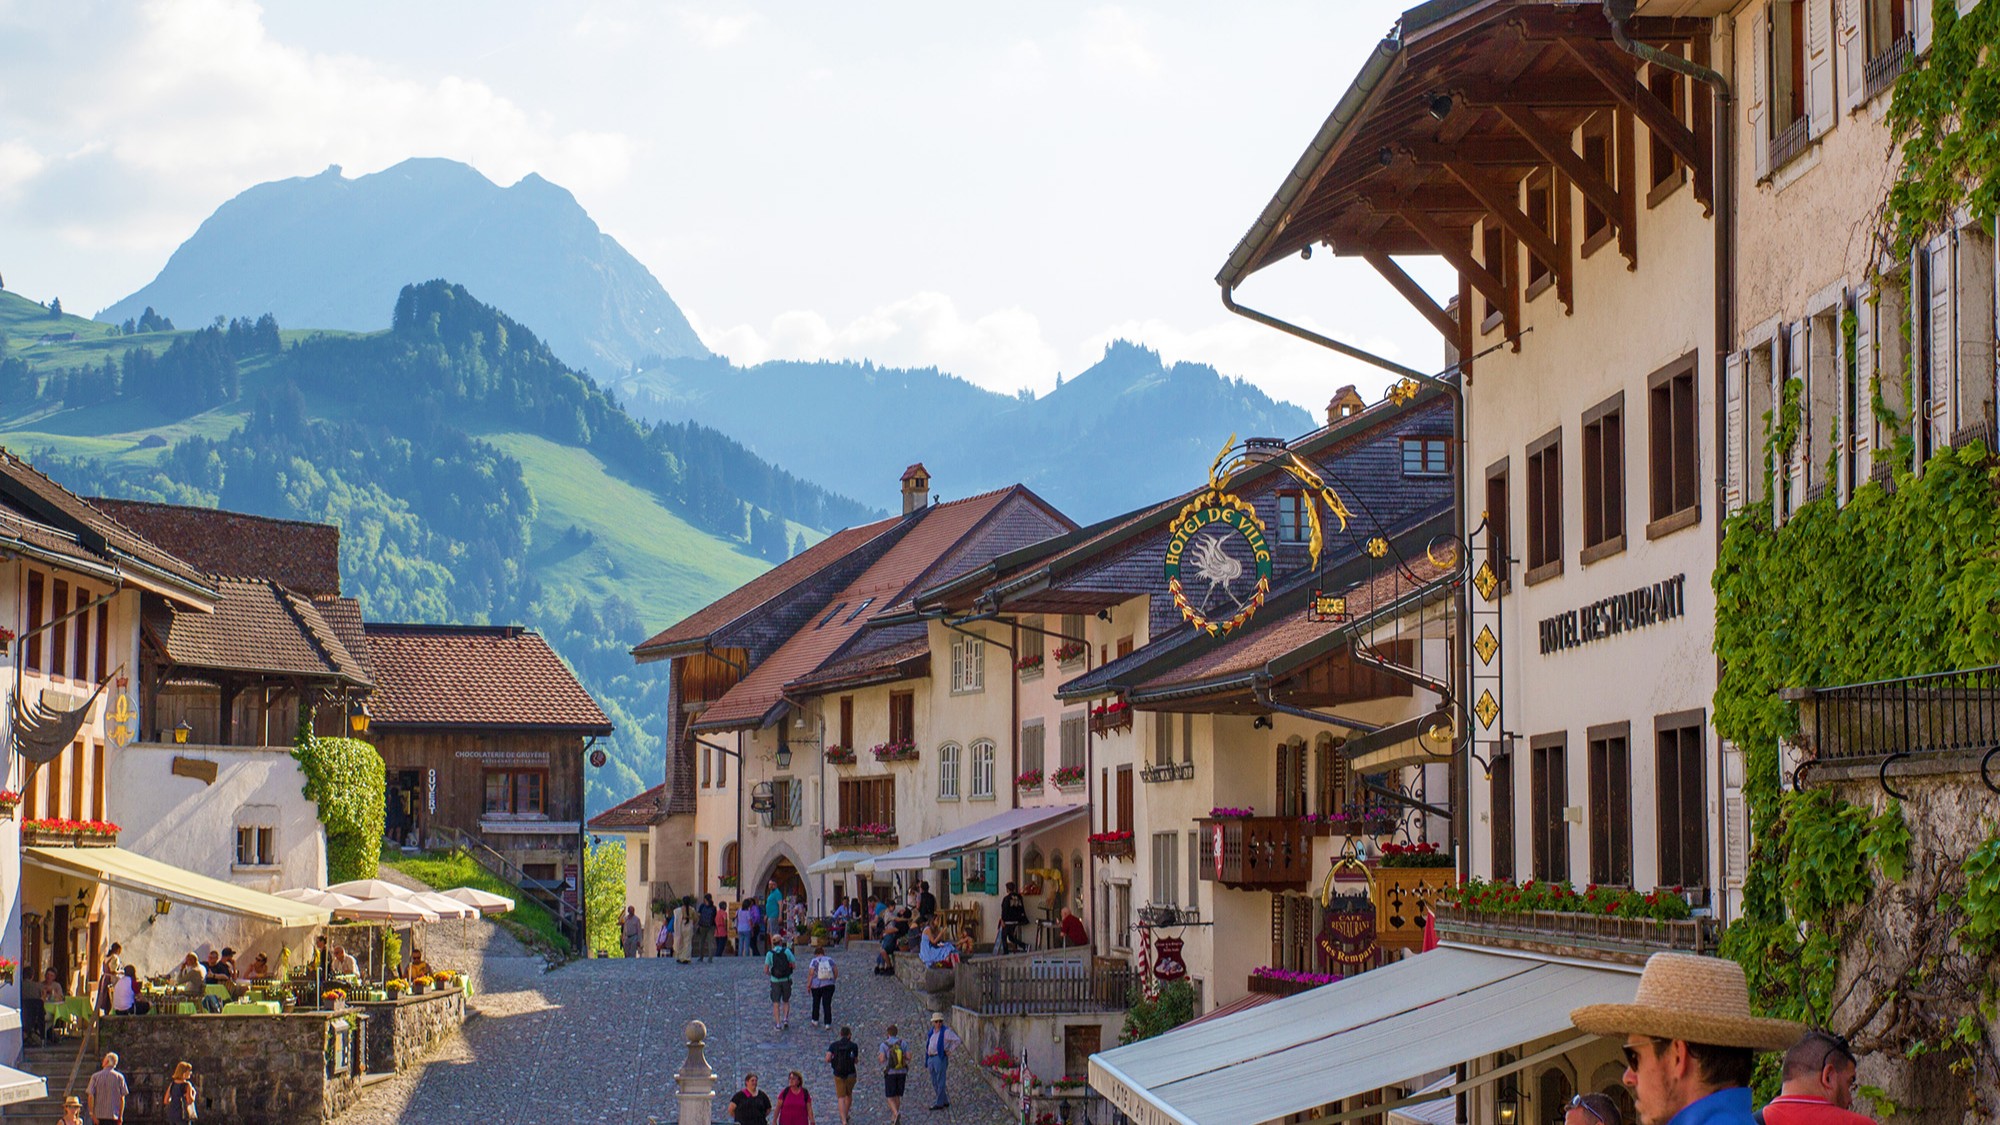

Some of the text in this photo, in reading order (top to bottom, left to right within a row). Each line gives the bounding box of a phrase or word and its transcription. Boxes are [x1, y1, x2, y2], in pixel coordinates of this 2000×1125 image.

[1166, 508, 1271, 565] HOTEL DE VILLE
[1538, 573, 1685, 655] HOTEL RESTAURANT
[428, 768, 436, 815] OUVERT
[1321, 939, 1336, 957] des
[1331, 921, 1369, 938] RESTAURANT
